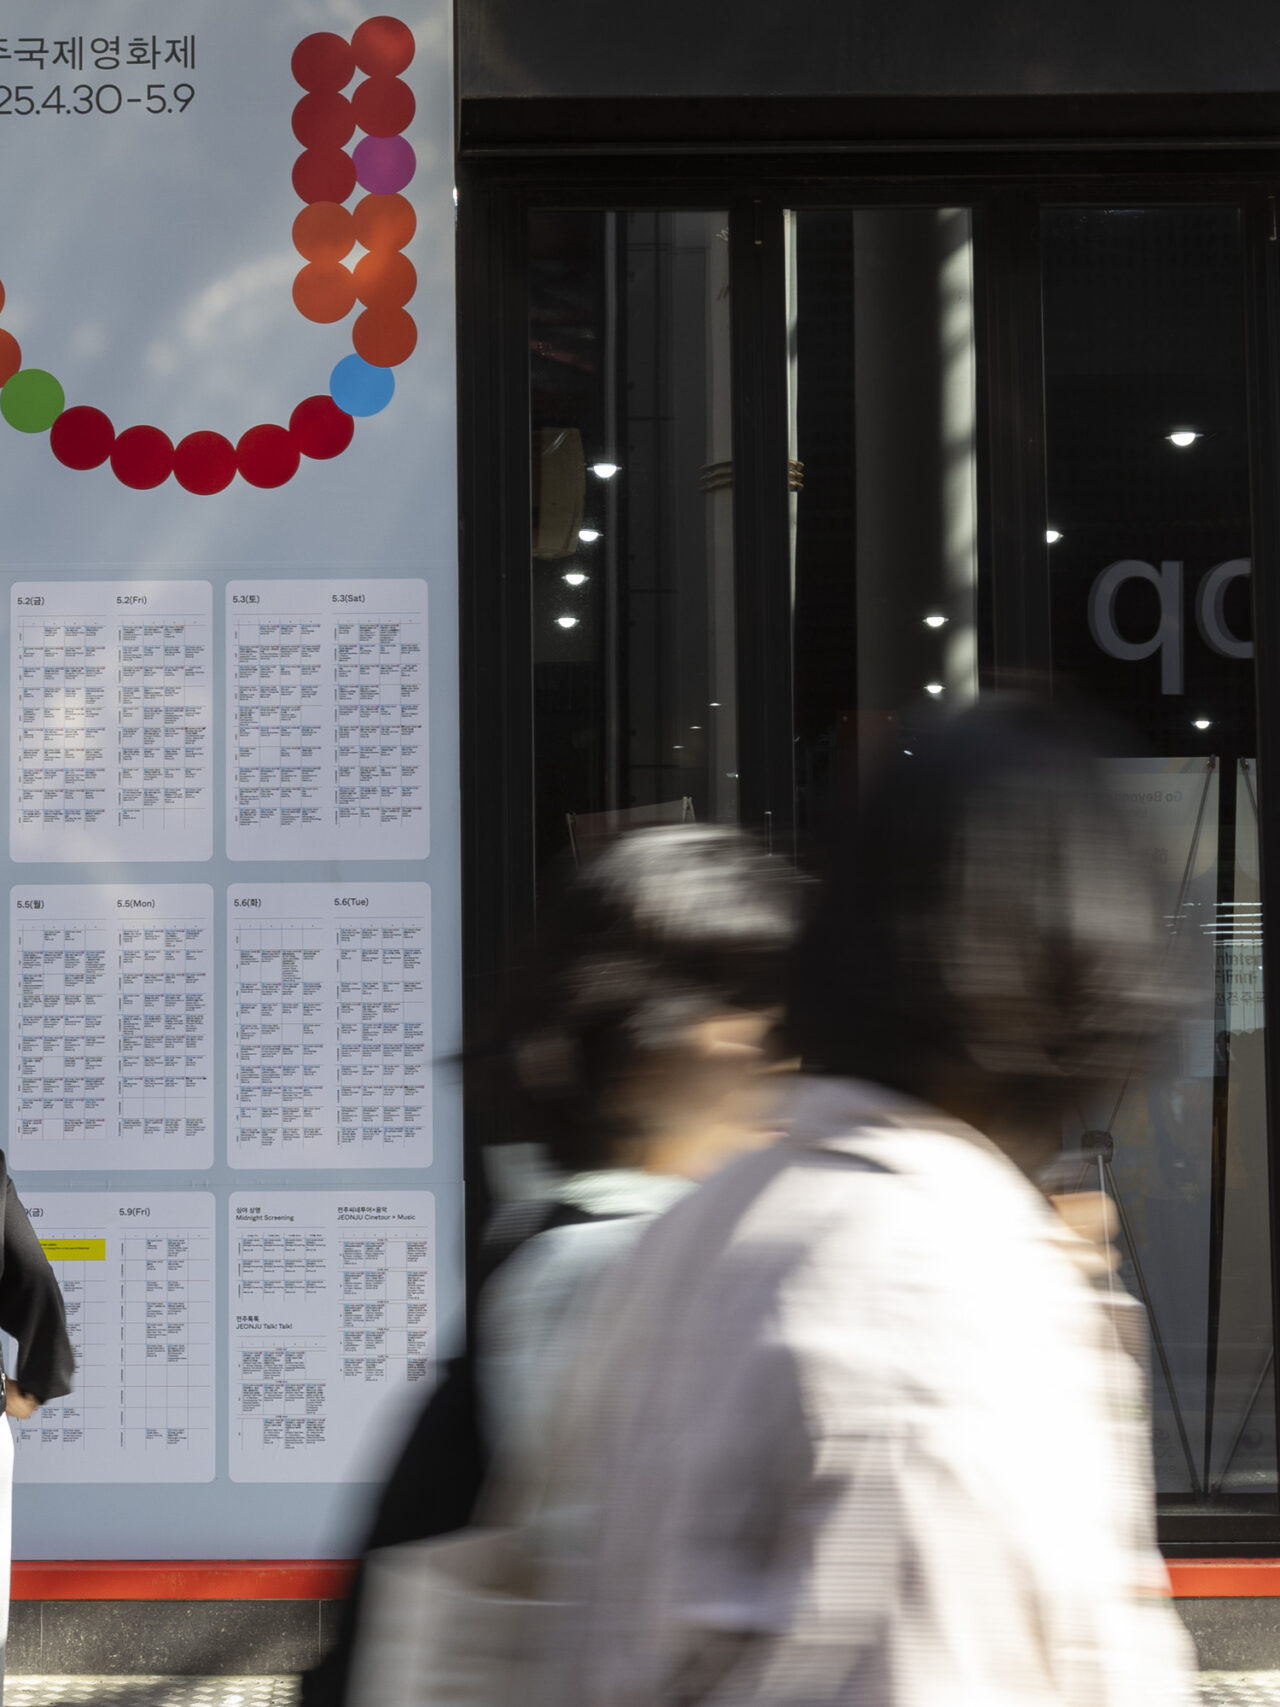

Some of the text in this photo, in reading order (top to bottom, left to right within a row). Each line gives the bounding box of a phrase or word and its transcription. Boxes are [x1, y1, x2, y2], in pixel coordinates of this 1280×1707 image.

[17, 596, 147, 606] 5.2(금) 5.2(Fri)
[233, 594, 365, 604] 5.3(토) 5.3(Sat)
[117, 899, 155, 908] 5.5(Mon)
[334, 898, 369, 907] 5.6(Tue)
[119, 1208, 150, 1216] 5.9(Fri)
[236, 1214, 294, 1222] Midnight Screening
[337, 1213, 362, 1221] JEONJU
[364, 1213, 391, 1221] Cinetour
[397, 1213, 416, 1221] Music
